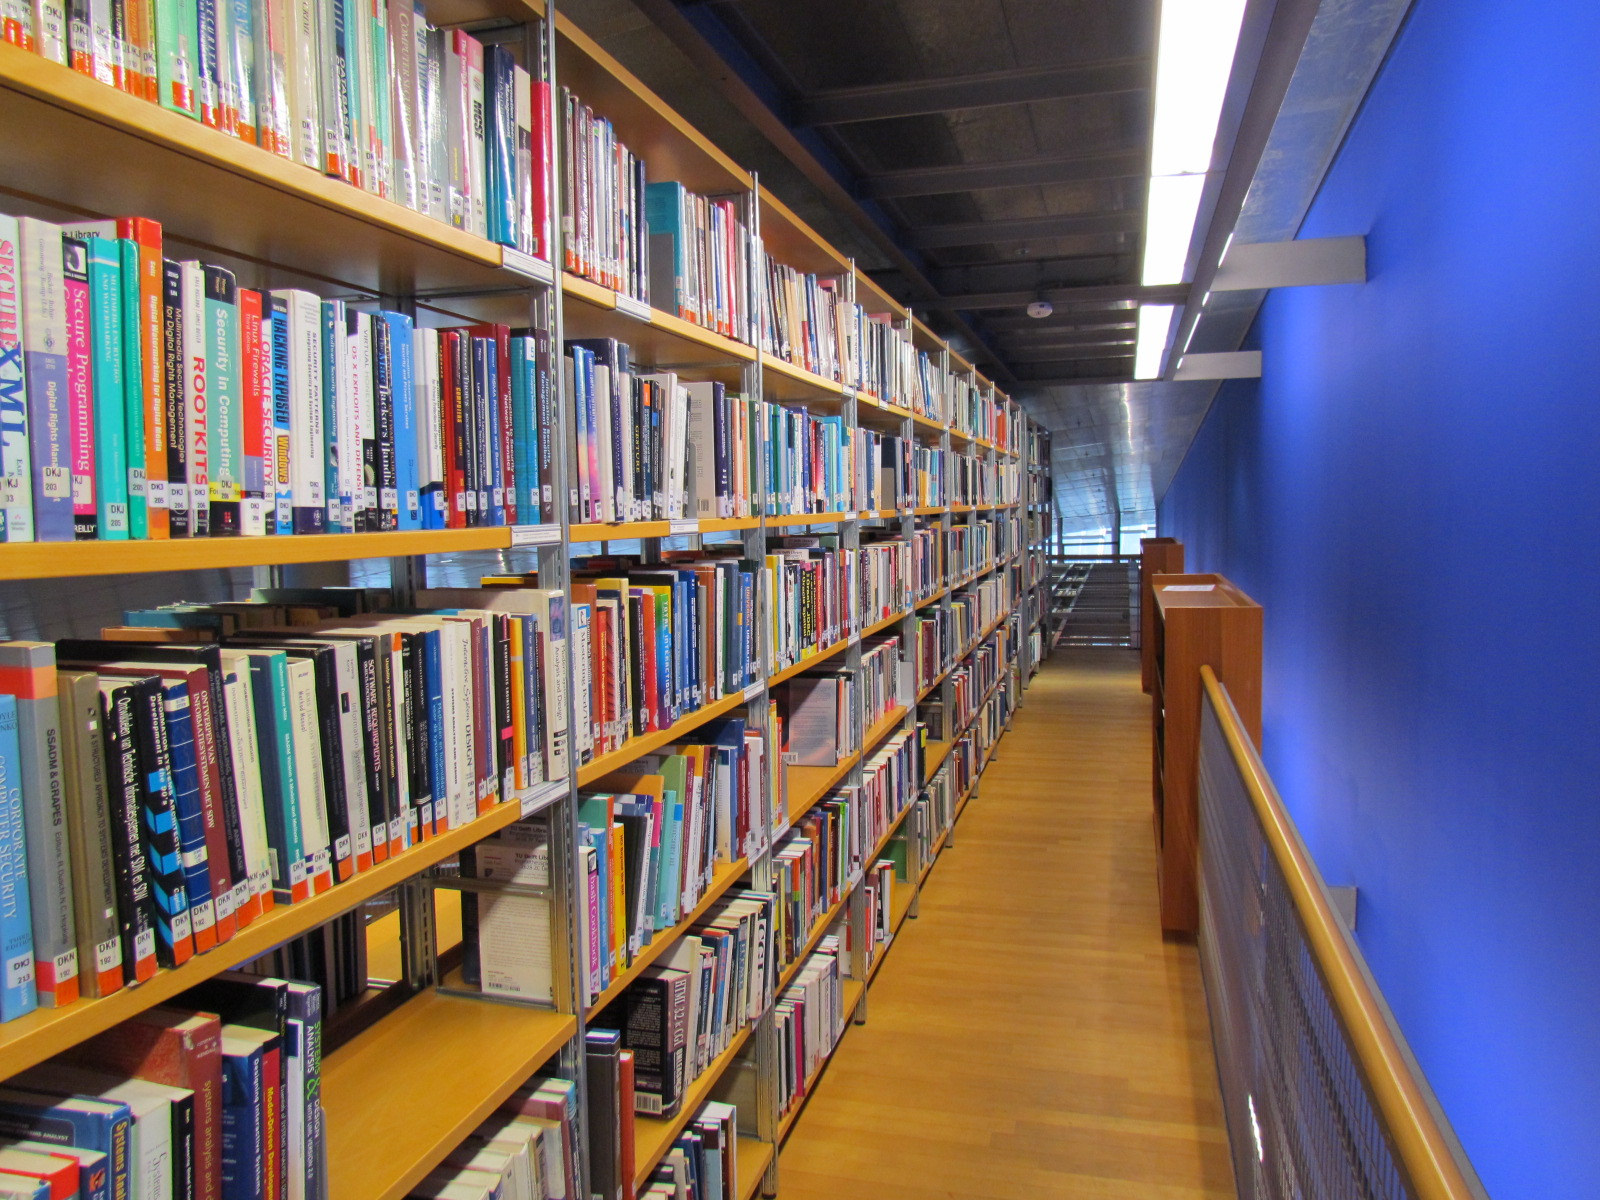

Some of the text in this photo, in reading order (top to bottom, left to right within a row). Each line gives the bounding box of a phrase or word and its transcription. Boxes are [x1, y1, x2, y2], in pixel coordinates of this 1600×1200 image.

[474, 100, 483, 141] MCSE
[71, 231, 100, 240] Library
[0, 237, 18, 349] SECURE
[150, 296, 158, 322] Digital
[167, 321, 175, 351] Digital
[216, 308, 228, 372] Security
[251, 315, 260, 396] Linux Firewalls
[352, 346, 357, 360] OS
[74, 289, 92, 470] Secure Programming
[167, 354, 176, 380] Rights
[218, 378, 229, 390] in
[274, 318, 289, 422] HACKING EXPOSED
[0, 341, 26, 447] XML
[46, 382, 58, 441] Digital Rights
[169, 383, 177, 448] Management
[262, 341, 273, 479] ORACLE SECURITY
[194, 356, 208, 484] ROOTKITS
[218, 395, 231, 476] Computing
[46, 468, 61, 476] DKJ
[278, 435, 289, 484] Windows
[111, 505, 124, 514] DKJ
[201, 690, 213, 744] ONTWERPEN
[368, 659, 381, 771] SOFTWARE REQUIREMENTS
[47, 729, 59, 771] SSADM
[92, 741, 100, 781] STRUCTURED
[150, 695, 162, 754] Development
[157, 757, 163, 765] in
[160, 786, 168, 805] 90's
[193, 692, 215, 828] INFORMATIESYSTEMEN MET SDW
[351, 703, 366, 828] Information Systems Engineering
[51, 772, 58, 780] &
[157, 692, 182, 865] INFORMATION SYSTEMS ARCHITECTURE
[51, 782, 62, 826] GRAPES
[10, 788, 26, 880] CORPORATE
[99, 831, 107, 859] SYSTEMS
[1, 845, 17, 918] SECURITY
[102, 860, 111, 904] DEVELOPMENT
[194, 904, 208, 915] DKN
[57, 953, 75, 967] DKN
[99, 940, 116, 952] DKN
[137, 934, 150, 944] DKN
[14, 958, 30, 970] DKJ
[18, 974, 31, 984] 213
[60, 970, 70, 978] 192
[100, 957, 111, 966] 192
[675, 979, 686, 1005] HTML
[307, 1025, 315, 1074] ANALYSIS
[307, 1078, 320, 1100] &
[42, 1131, 69, 1141] ANALYST
[115, 1121, 128, 1172] Systems
[203, 1080, 214, 1192] systems analysis and
